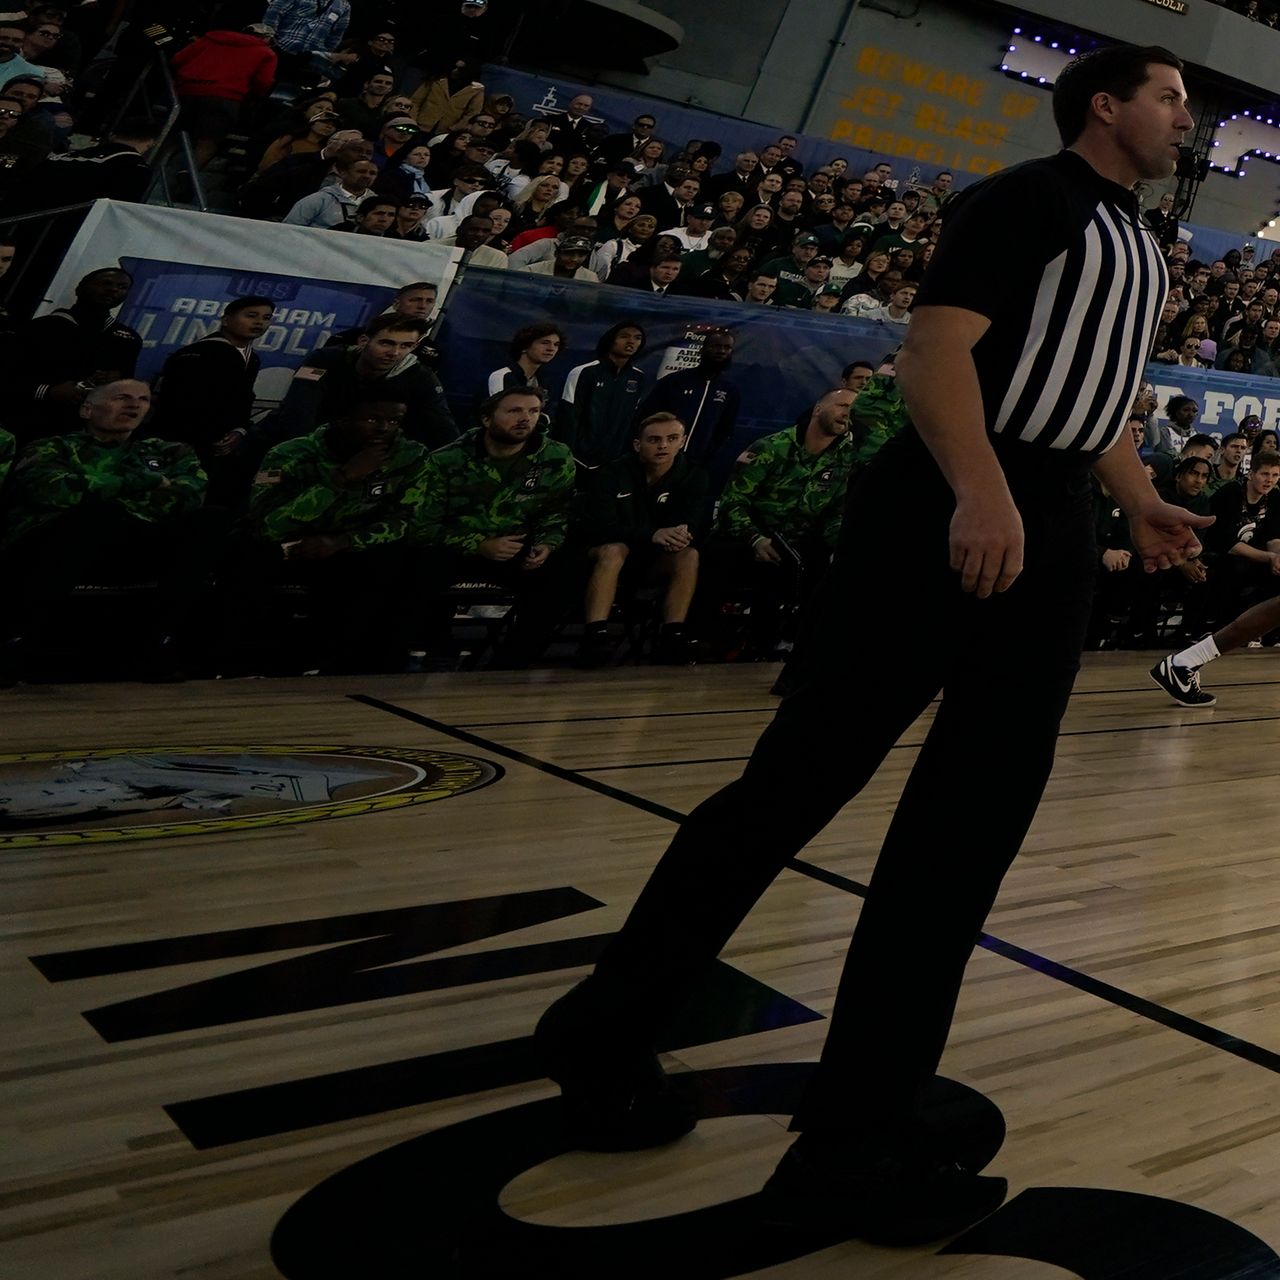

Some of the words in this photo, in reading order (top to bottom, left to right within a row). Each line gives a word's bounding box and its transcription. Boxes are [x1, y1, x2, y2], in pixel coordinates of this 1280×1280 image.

[856, 46, 985, 107] BEWARE
[1001, 91, 1039, 118] OF
[842, 86, 903, 118] JET
[915, 105, 1007, 146] BLAST
[171, 298, 336, 328] ABHAM
